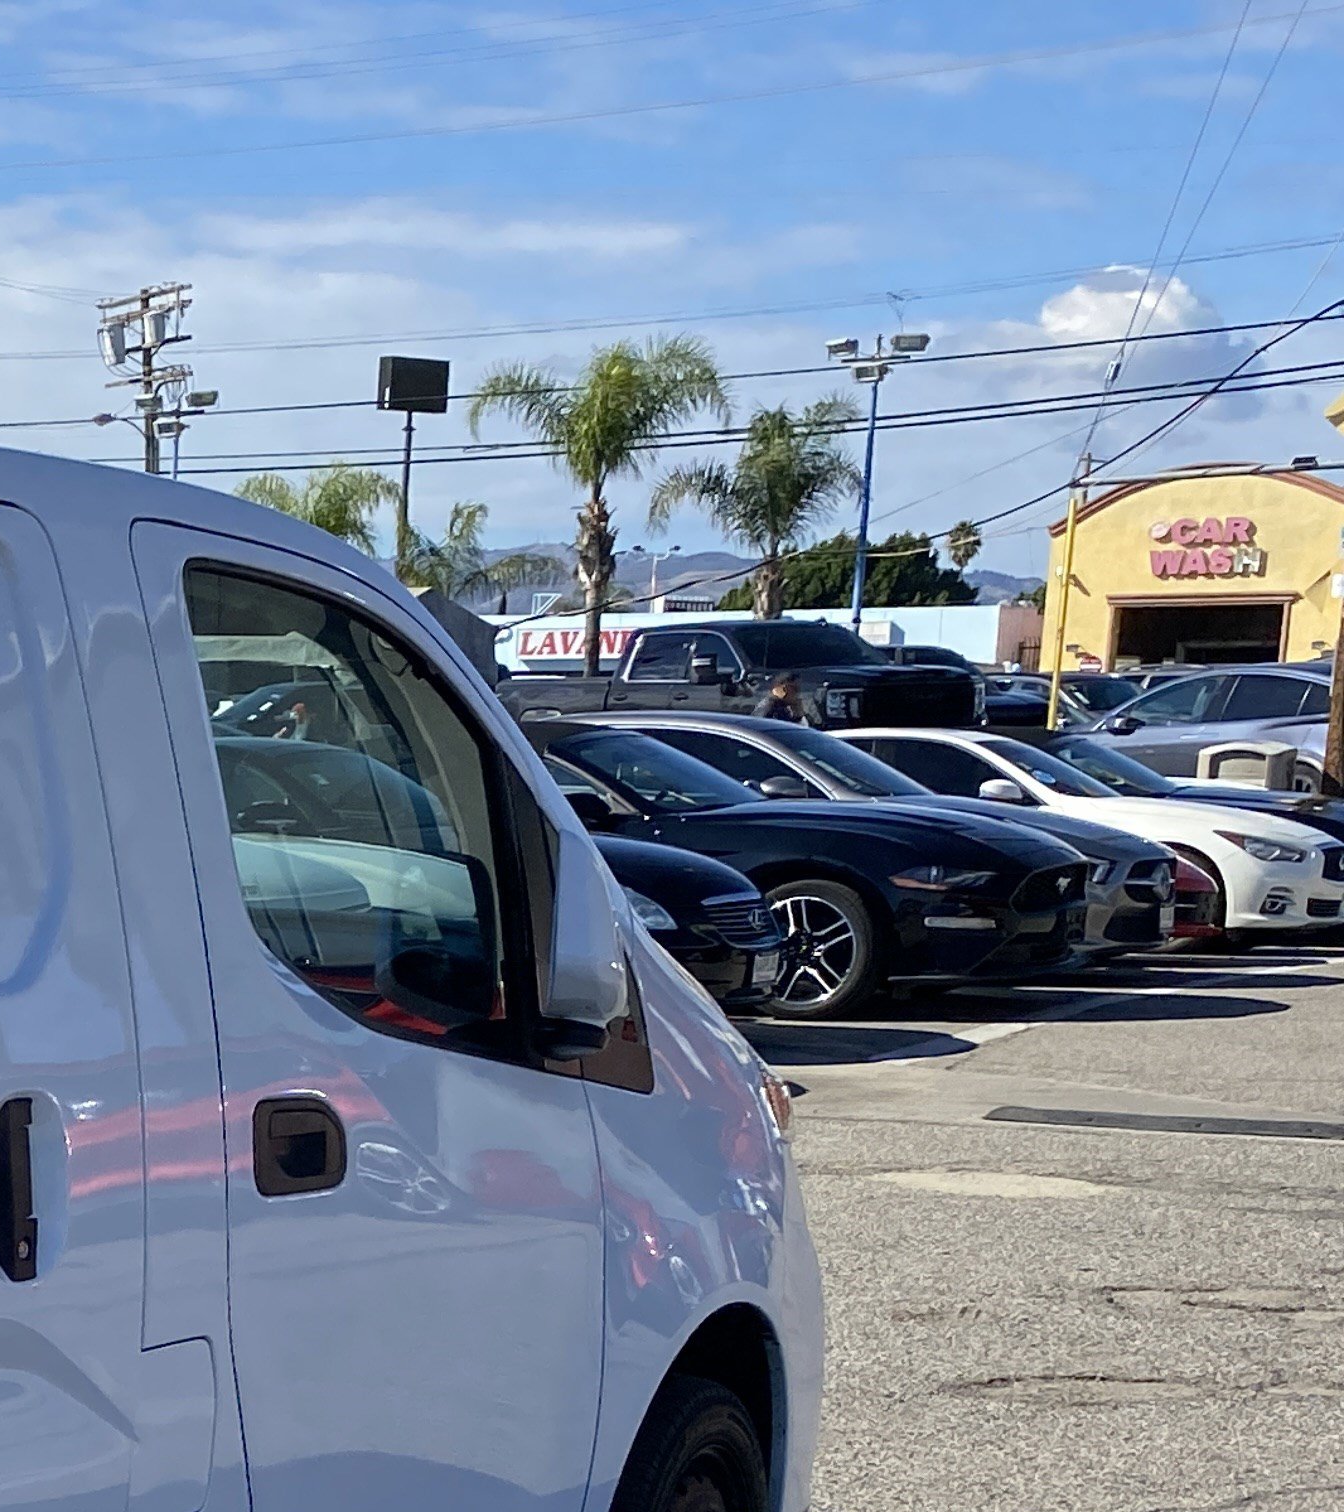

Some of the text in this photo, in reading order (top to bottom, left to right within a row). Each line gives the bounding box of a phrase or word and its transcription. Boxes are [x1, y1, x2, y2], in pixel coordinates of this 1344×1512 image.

[1169, 516, 1252, 546] CAR
[1150, 546, 1263, 577] WASH
[519, 630, 634, 655] LAVN
